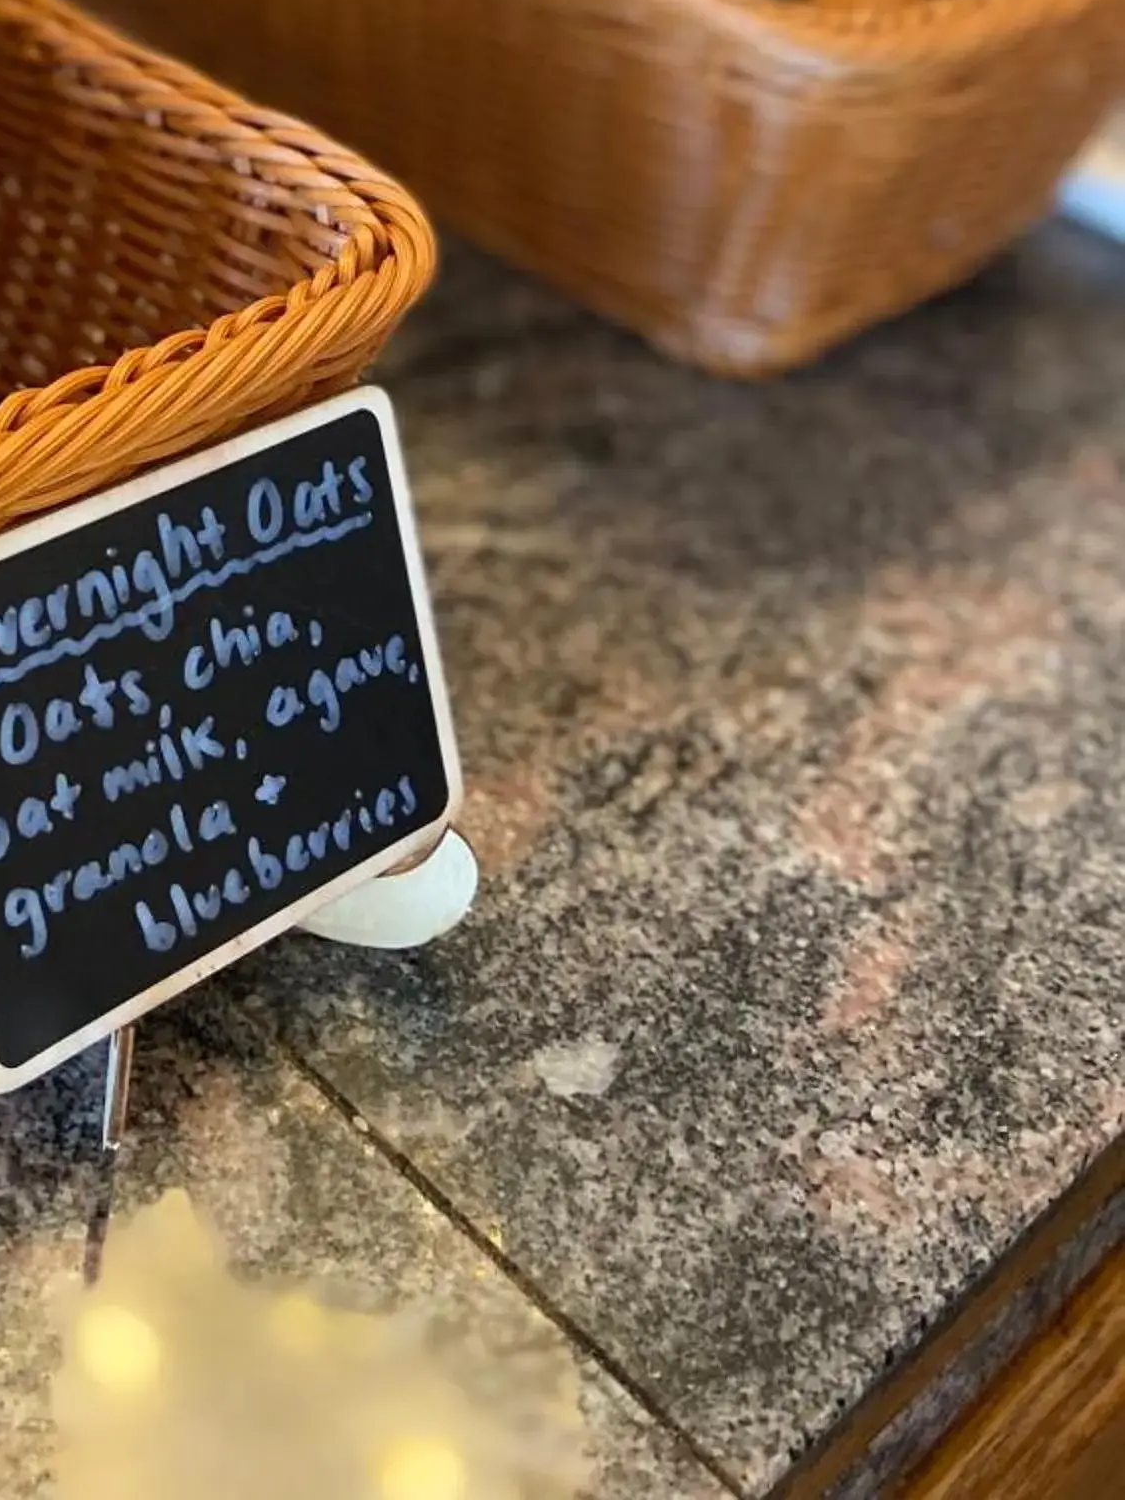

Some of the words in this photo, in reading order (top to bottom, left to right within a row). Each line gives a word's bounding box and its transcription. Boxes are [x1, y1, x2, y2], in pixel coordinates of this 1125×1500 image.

[248, 456, 372, 543] Oats
[183, 605, 322, 690] chia,
[266, 635, 419, 732] agave,
[5, 801, 236, 957] granola
[135, 776, 416, 951] blueberries
